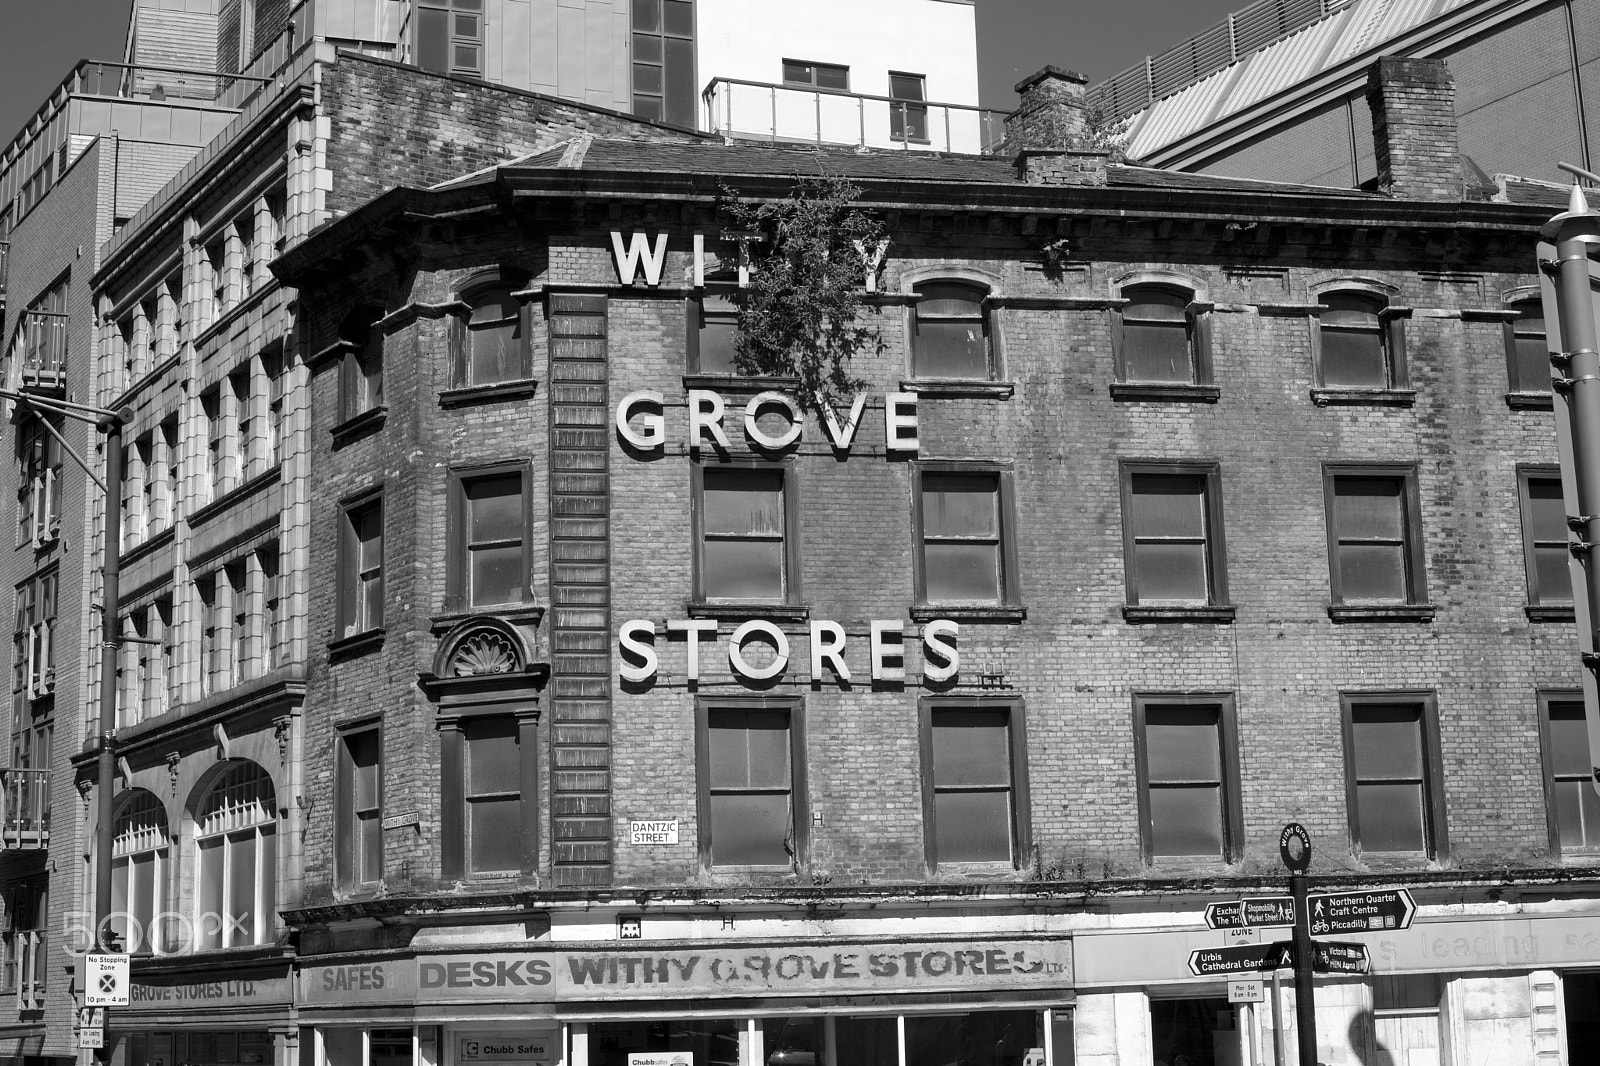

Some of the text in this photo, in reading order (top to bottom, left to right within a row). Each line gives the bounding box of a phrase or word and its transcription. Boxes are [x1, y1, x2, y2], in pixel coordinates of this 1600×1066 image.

[610, 231, 890, 293] WITY
[616, 390, 919, 450] GROVE
[619, 619, 960, 681] STORES
[632, 822, 676, 832] DANTZIC
[634, 832, 670, 842] STREET
[1281, 825, 1310, 848] Withy Grove
[1329, 894, 1397, 907] Northern Quarter
[1330, 905, 1379, 917] Craft Centre
[1216, 916, 1242, 925] The Tri
[1248, 913, 1279, 923] Market Street
[1331, 919, 1368, 930] Piccadilly
[99, 956, 128, 964] Stopping
[1200, 952, 1222, 962] Urbis
[567, 956, 700, 984] WITHY
[869, 950, 1044, 977] STORES
[1201, 958, 1278, 971] Cathedral Gardens
[322, 965, 385, 992] SAFES
[419, 959, 553, 988] DESKS
[131, 984, 171, 1001] GROVE
[175, 981, 223, 1000] STORES
[483, 1044, 545, 1054] Chubb Safes
